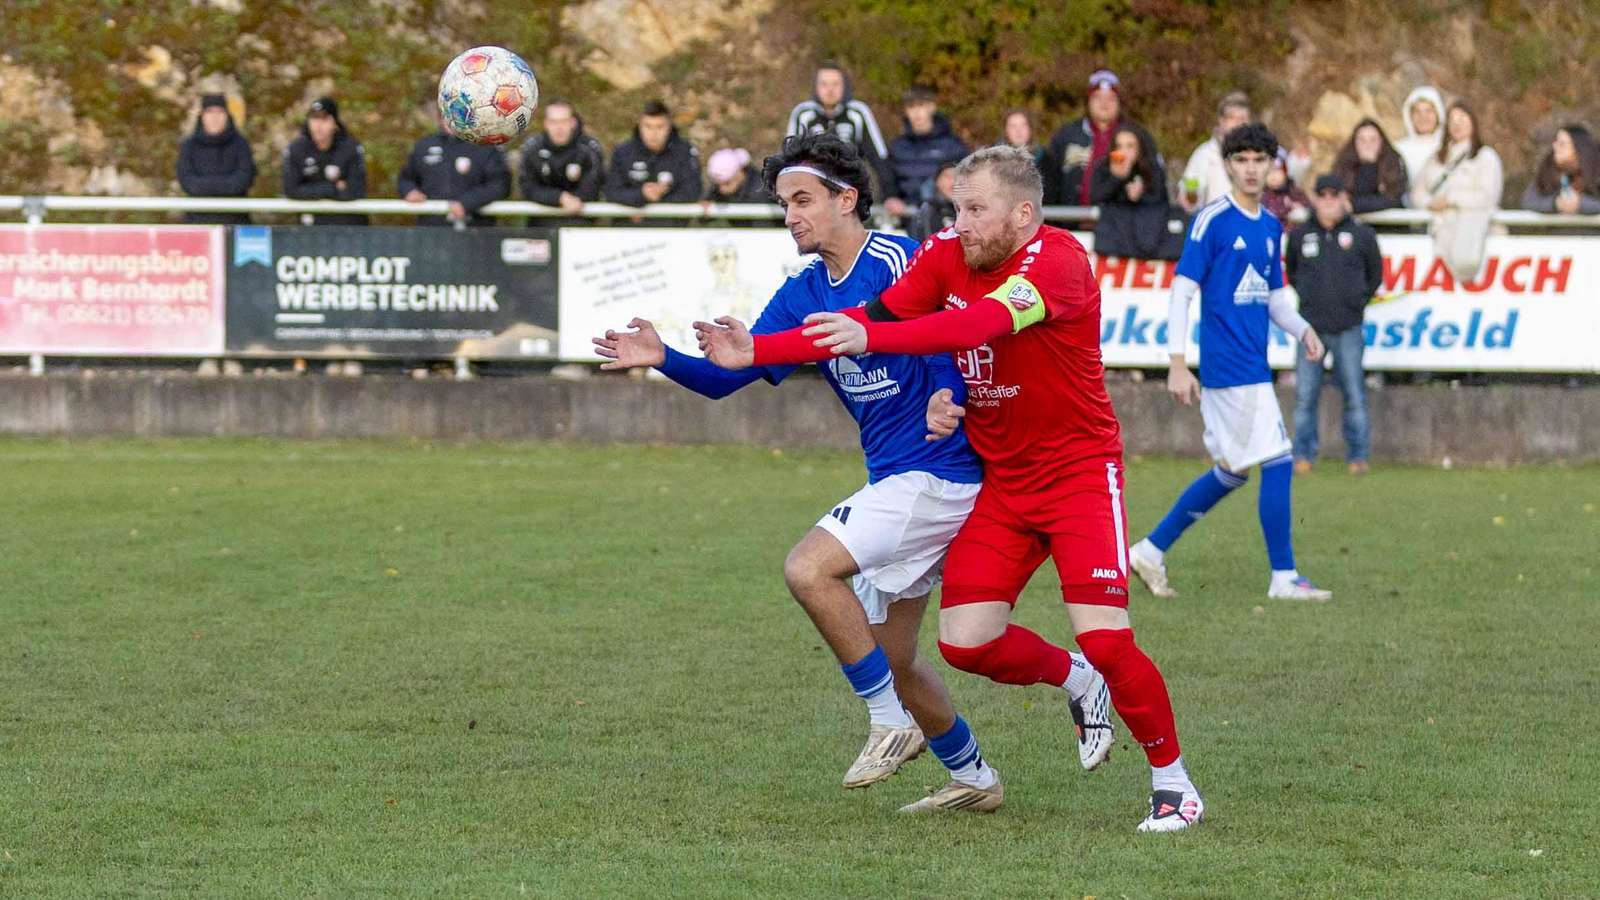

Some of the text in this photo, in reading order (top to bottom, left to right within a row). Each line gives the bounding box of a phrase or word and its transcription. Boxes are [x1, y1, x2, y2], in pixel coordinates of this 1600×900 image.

[276, 256, 411, 283] COMPLOT
[1382, 256, 1572, 292] MAUCH
[13, 276, 207, 302] Mark Bernhardt
[275, 283, 500, 313] WERBETECHNIK
[946, 293, 968, 310] JAKO
[977, 384, 1021, 399] Pfeffer
[1091, 568, 1118, 579] JAKO
